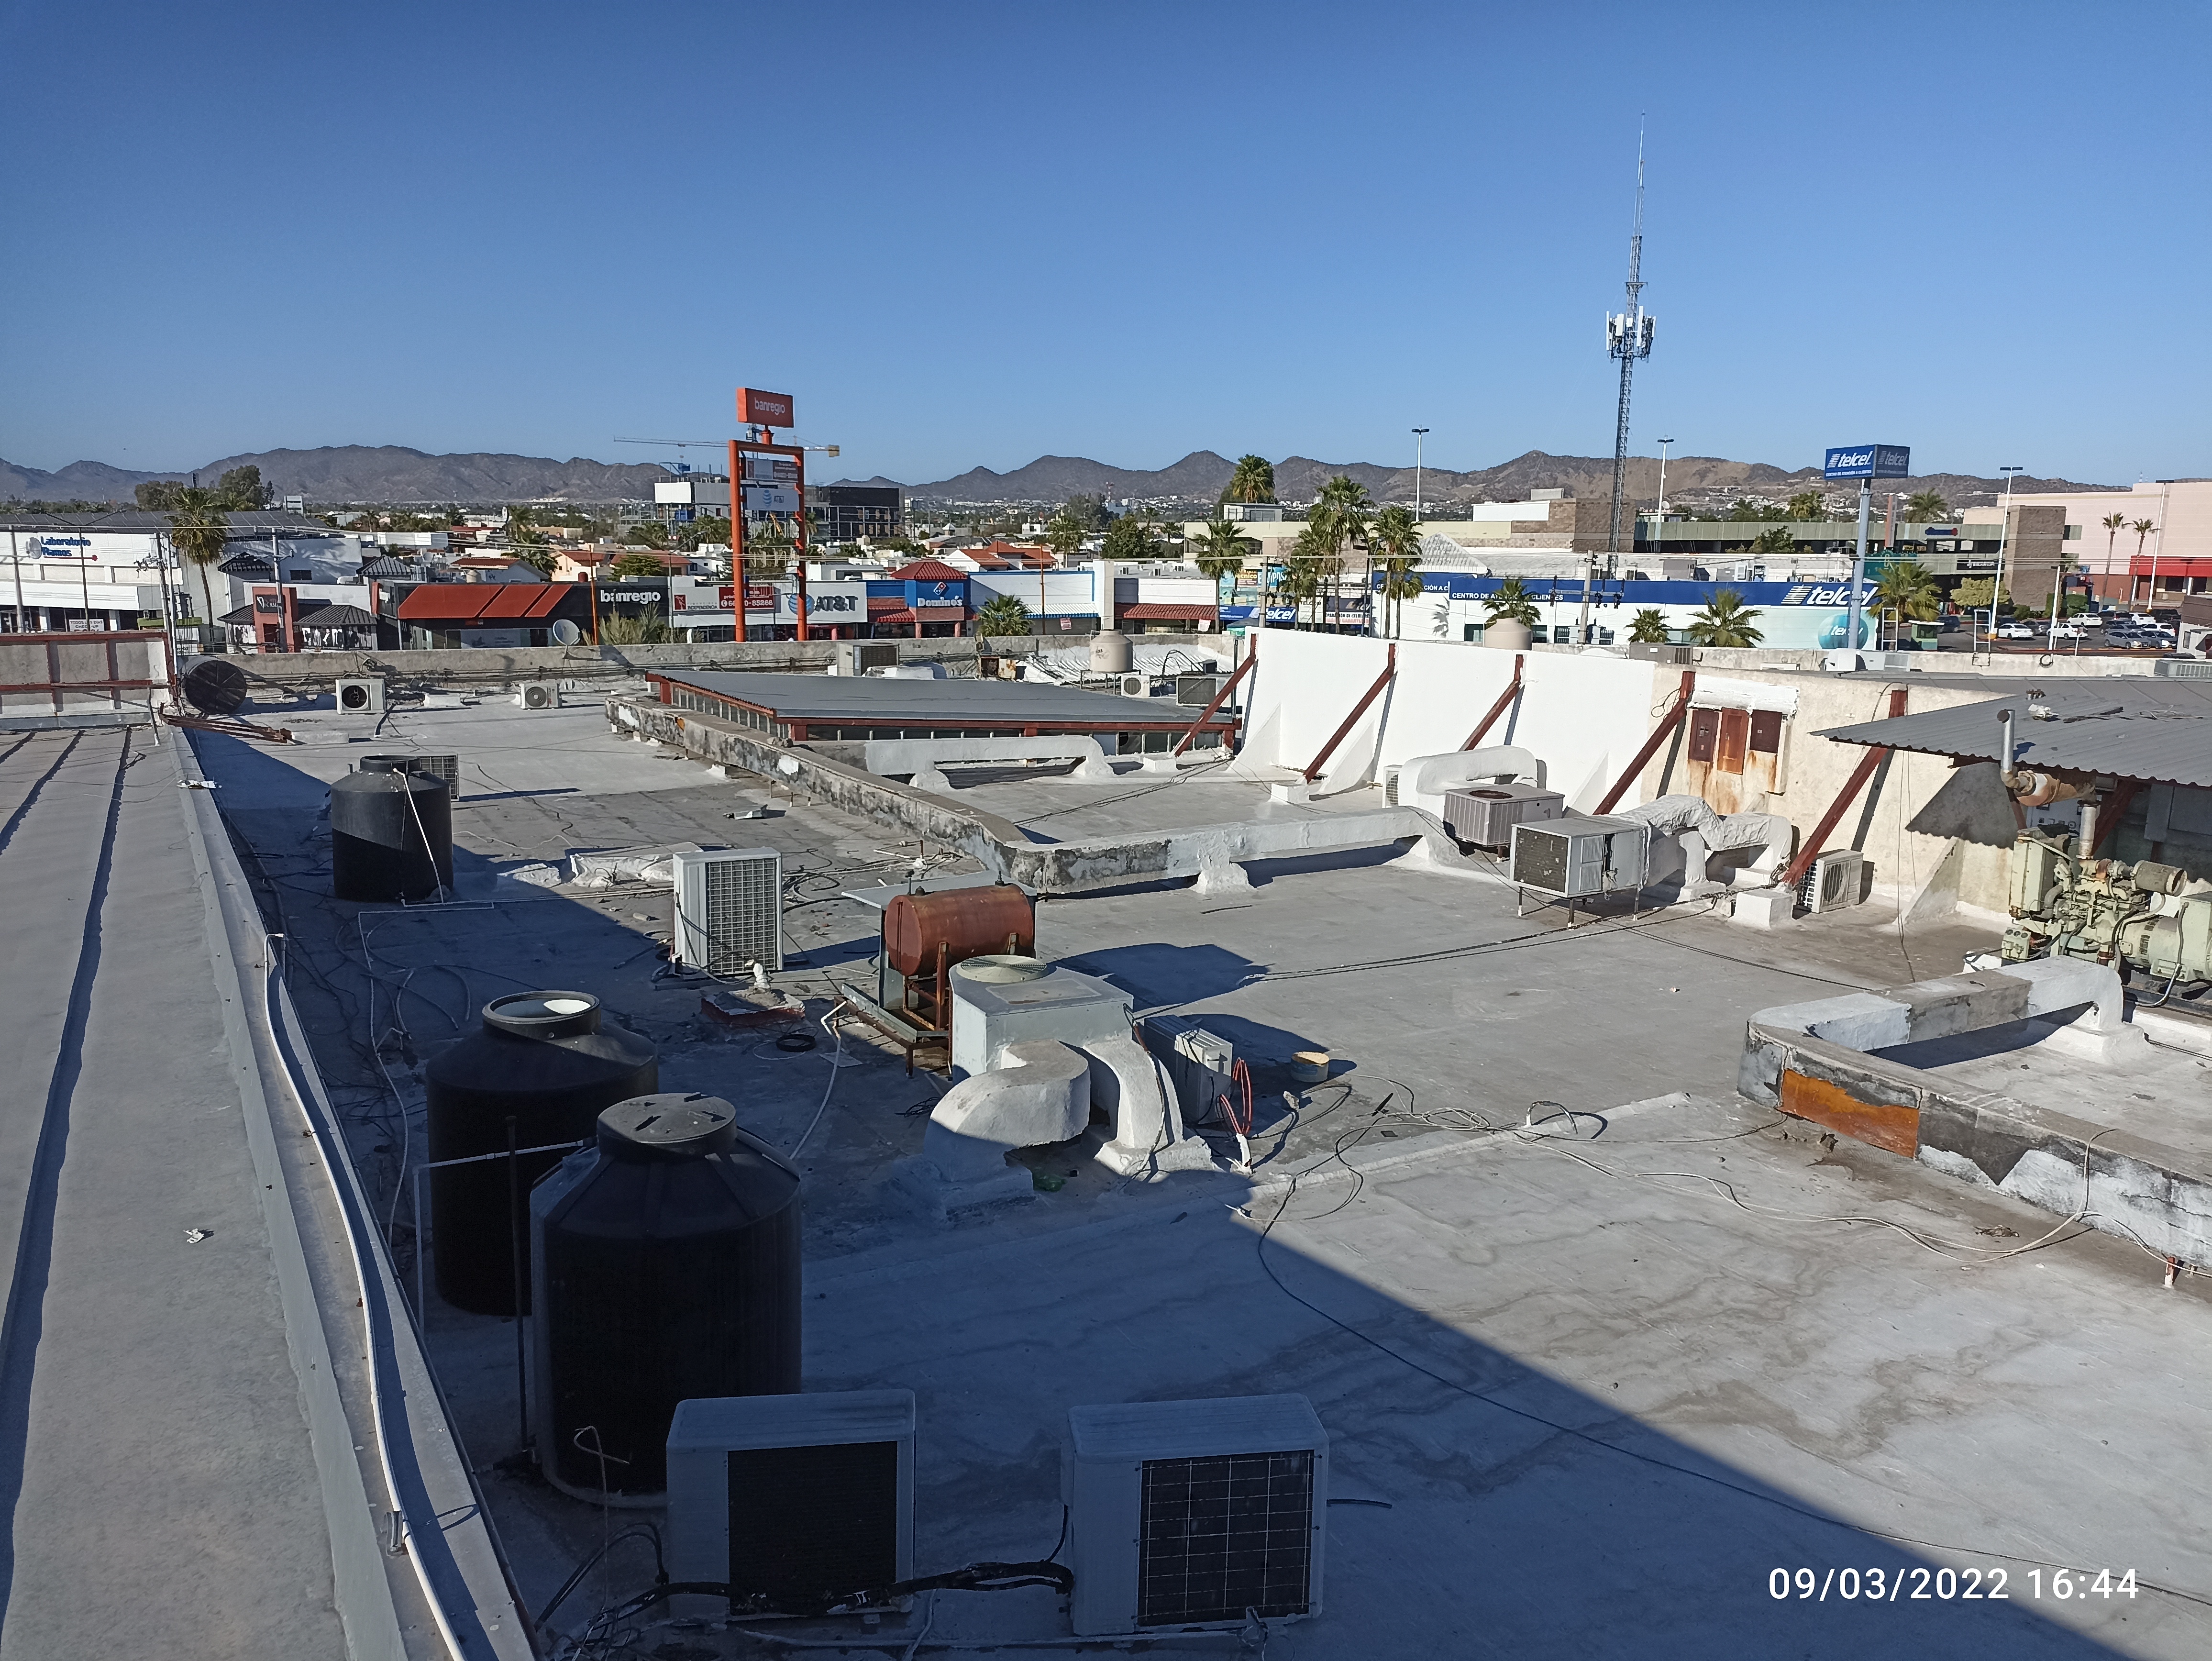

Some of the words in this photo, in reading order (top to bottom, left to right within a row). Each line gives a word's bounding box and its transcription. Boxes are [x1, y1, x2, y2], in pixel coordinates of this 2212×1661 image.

[754, 397, 785, 415] banregio
[1838, 451, 1873, 467] telcel
[1885, 452, 1909, 466] telcel
[42, 547, 72, 556] Ramos
[600, 589, 661, 604] banregio
[814, 595, 859, 611] AT&T
[918, 595, 962, 607] Domino's
